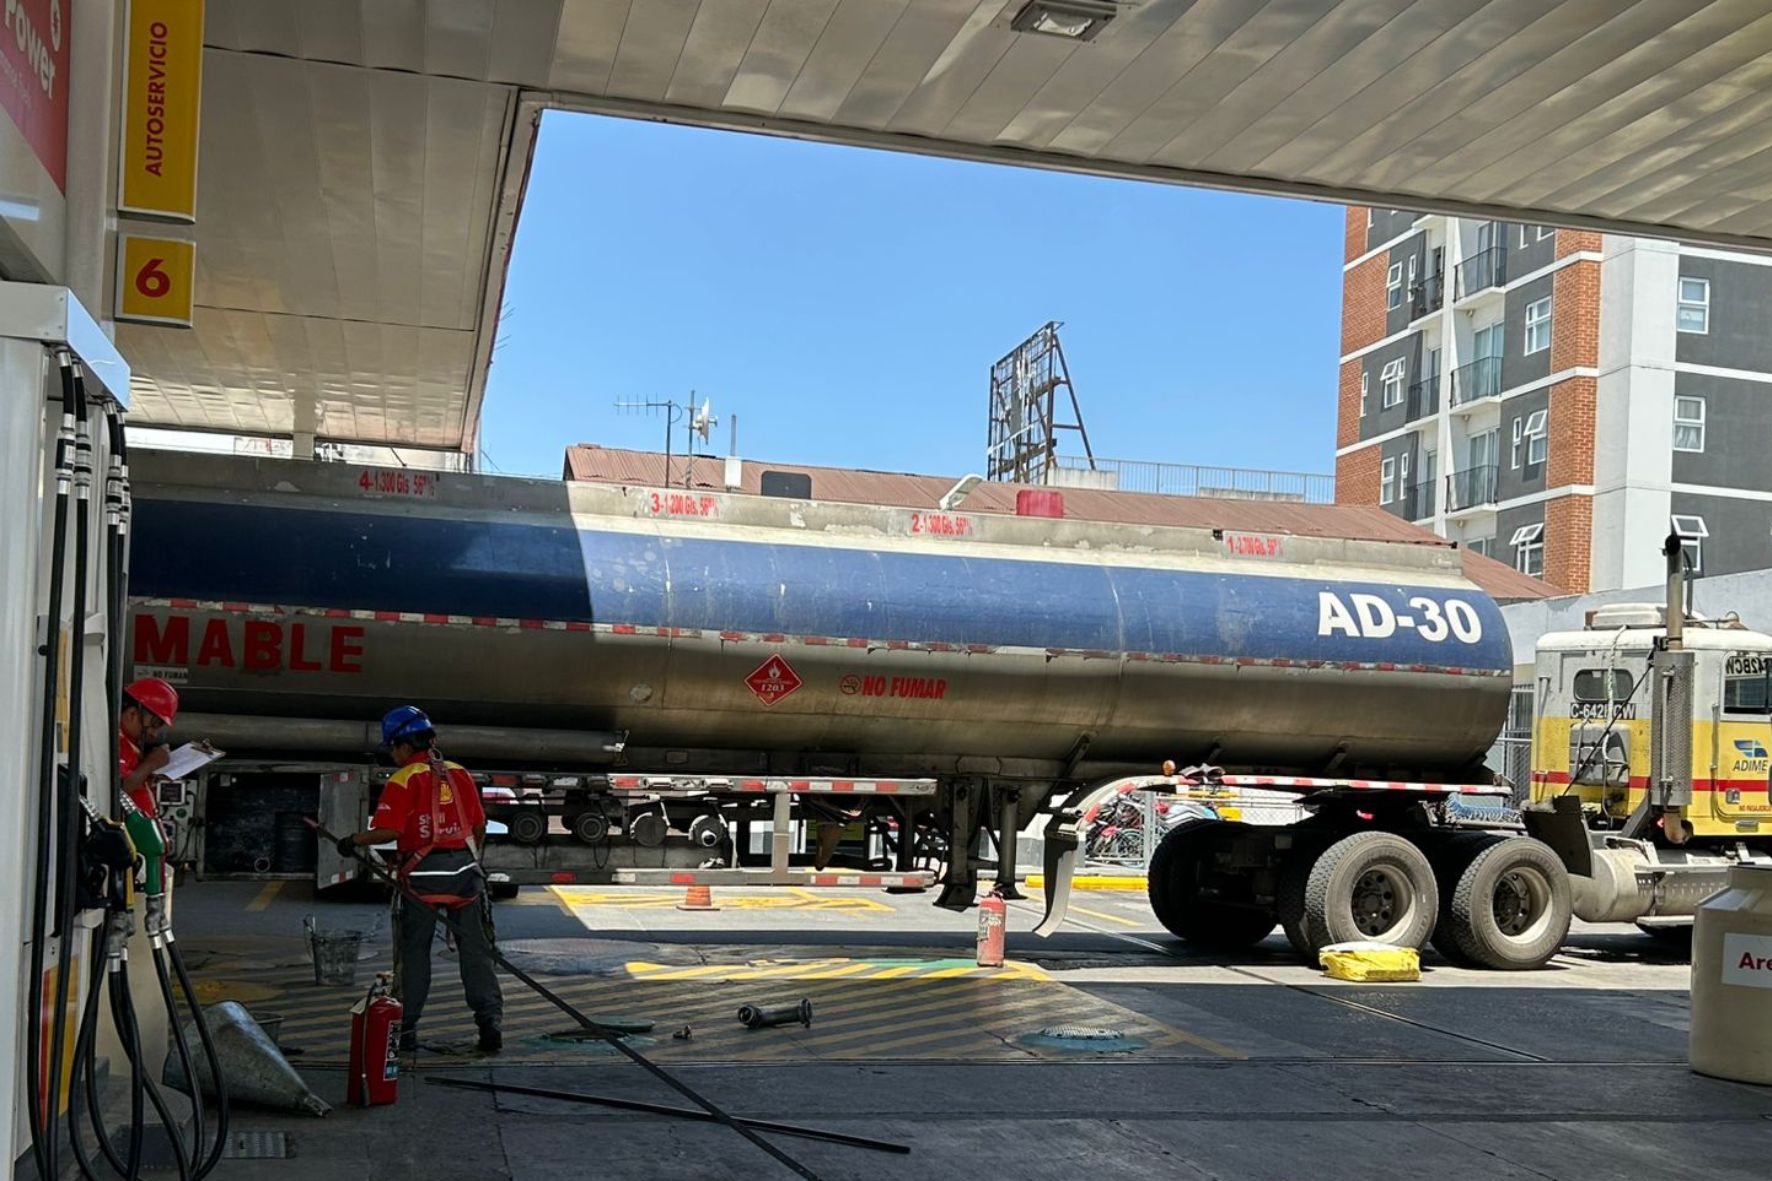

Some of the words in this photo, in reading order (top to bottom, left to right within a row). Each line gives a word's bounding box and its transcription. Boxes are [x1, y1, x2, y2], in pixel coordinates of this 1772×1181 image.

[145, 22, 168, 177] AUTOSERVICIO
[135, 258, 171, 298] 6
[1318, 591, 1482, 644] AD-30
[134, 614, 365, 672] MABLE
[862, 675, 887, 697] NO
[889, 676, 946, 699] FUMAR
[1733, 760, 1769, 772] ADIME
